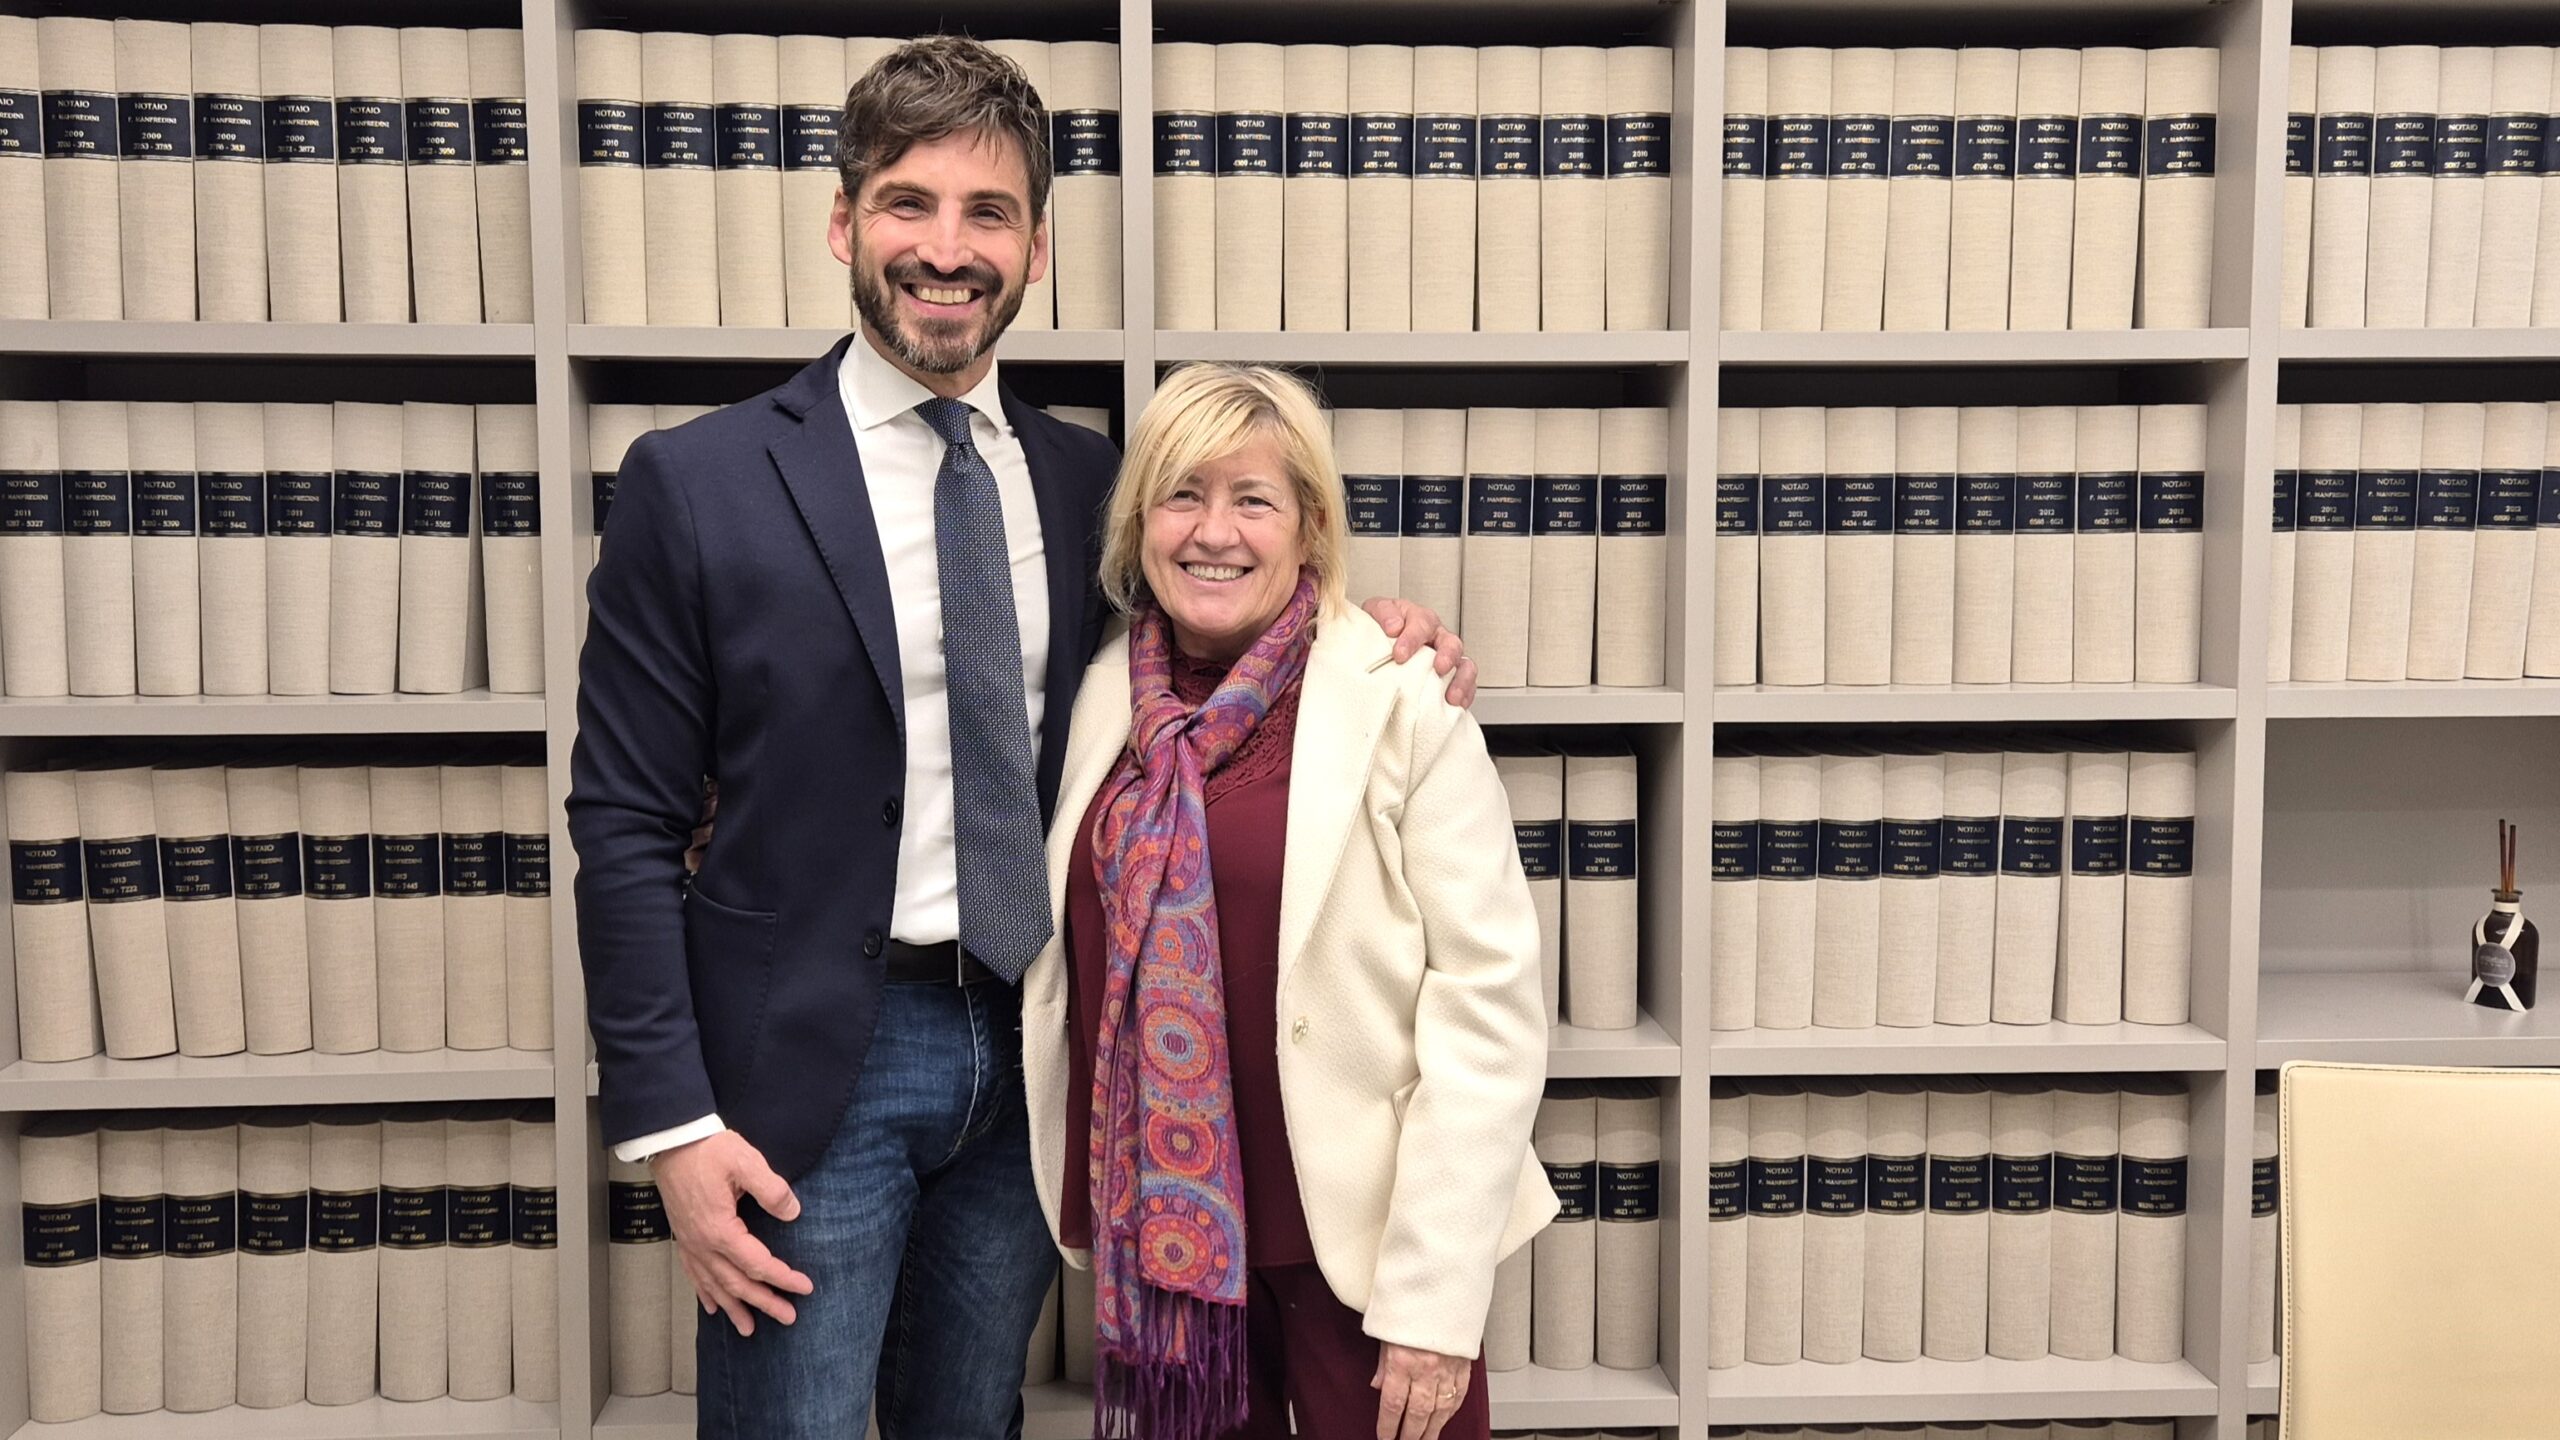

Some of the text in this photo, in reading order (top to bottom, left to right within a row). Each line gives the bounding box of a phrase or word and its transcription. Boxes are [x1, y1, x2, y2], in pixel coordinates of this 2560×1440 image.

[57, 99, 91, 109] NOTAIO
[134, 101, 168, 112] NOTAIO
[210, 102, 244, 113] NOTAIO
[594, 108, 627, 119] NOTAIO
[663, 111, 695, 121] NOTAIO
[799, 113, 832, 124] NOTAIO
[1069, 118, 1100, 128] NOTAIO
[1167, 119, 1198, 129] NOTAIO
[1235, 119, 1266, 129] NOTAIO
[1301, 120, 1332, 131] NOTAIO
[1366, 121, 1397, 131] NOTAIO
[1431, 122, 1462, 132] NOTAIO
[1782, 122, 1814, 132] NOTAIO
[1844, 122, 1876, 133] NOTAIO
[1976, 123, 2006, 133] NOTAIO
[2169, 121, 2200, 132] NOTAIO
[2335, 121, 2365, 130] NOTAIO
[2394, 121, 2425, 131] NOTAIO
[663, 125, 703, 134] MANFREDINI
[141, 131, 163, 141] 2009
[216, 132, 237, 142] 2009
[601, 138, 620, 148] 2010
[670, 140, 689, 150] 2010
[806, 142, 825, 152] 2010
[1076, 146, 1094, 156] 2010
[1174, 147, 1191, 157] 2010
[1240, 147, 1259, 157] 2010
[1306, 149, 1325, 159] 2010
[1372, 149, 1391, 159] 2010
[1438, 150, 1455, 160] 2010
[1788, 151, 1807, 160] 2010
[1850, 151, 1868, 161] 2010
[6, 479, 40, 489] NOTAIO
[143, 480, 177, 489] NOTAIO
[1780, 482, 1810, 491] NOTAIO
[1844, 482, 1876, 491] NOTAIO
[2032, 480, 2063, 489] NOTAIO
[2314, 477, 2345, 487] NOTAIO
[1487, 483, 1516, 492] NOTAIO
[1551, 483, 1581, 492] NOTAIO
[1619, 483, 1649, 492] NOTAIO
[14, 509, 32, 517] 2011
[151, 508, 169, 517] 2011
[1517, 829, 1545, 838] NOTAIO
[1587, 829, 1617, 838] NOTAIO
[1774, 829, 1804, 838] NOTAIO
[1838, 829, 1868, 838] NOTAIO
[1553, 1171, 1582, 1180] NOTAIO
[1764, 1166, 1794, 1175] NOTAIO
[1824, 1166, 1854, 1175] NOTAIO
